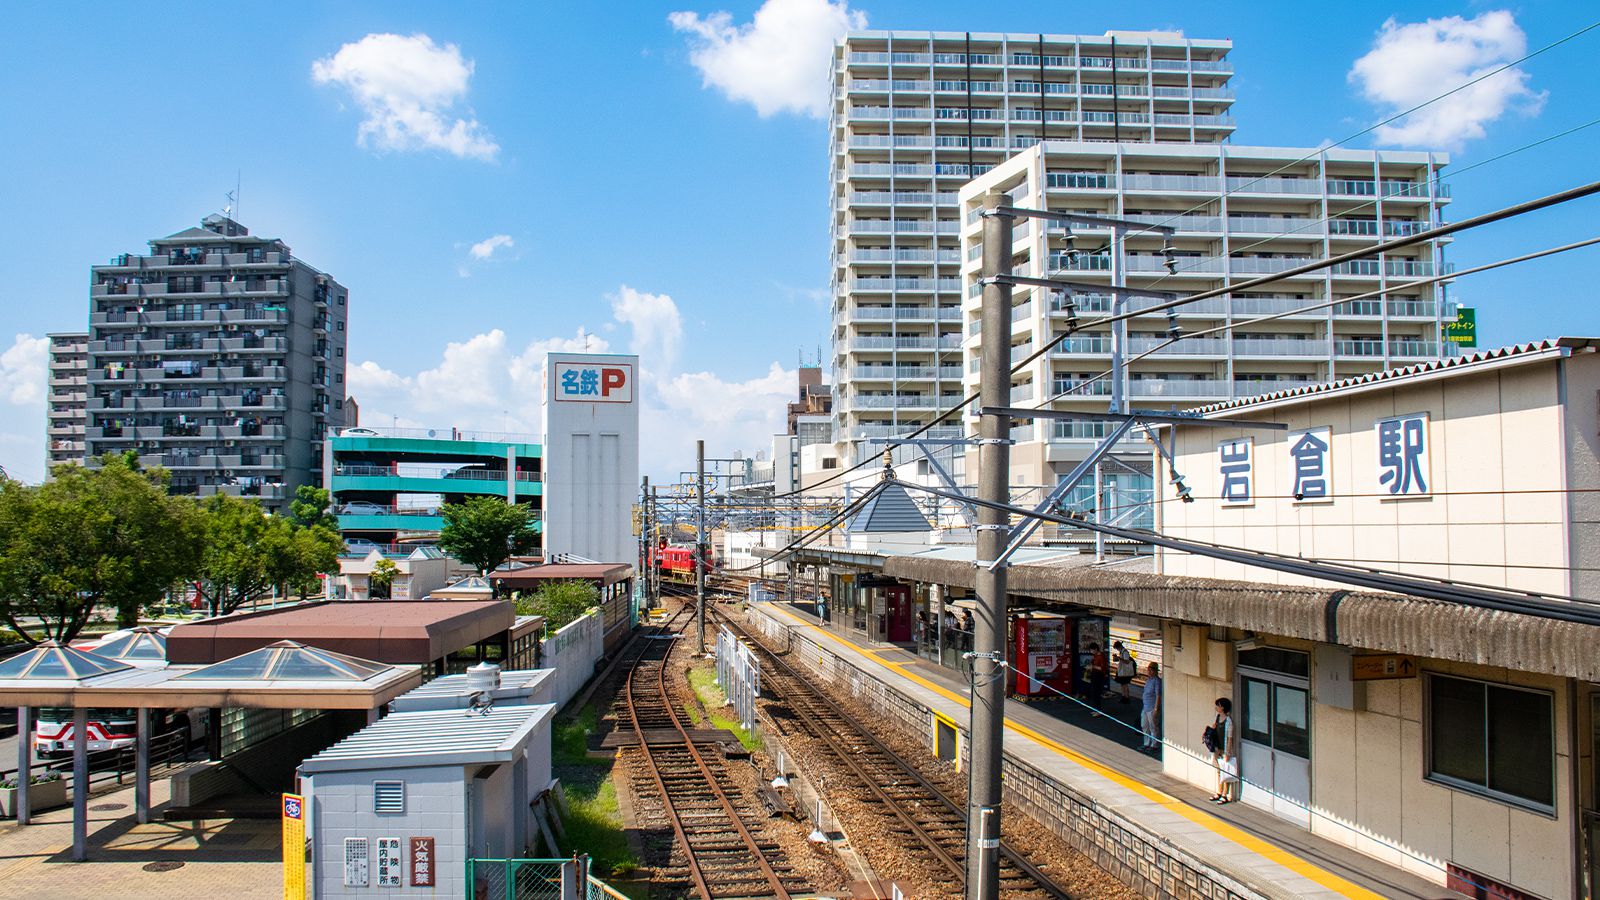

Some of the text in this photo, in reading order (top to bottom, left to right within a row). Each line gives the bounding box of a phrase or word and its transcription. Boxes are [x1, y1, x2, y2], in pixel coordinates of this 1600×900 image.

[561, 368, 626, 397] 名鉄 P
[1220, 419, 1427, 502] 岩倉駅
[389, 839, 400, 885] 危険物
[415, 840, 429, 884] 火気厳禁
